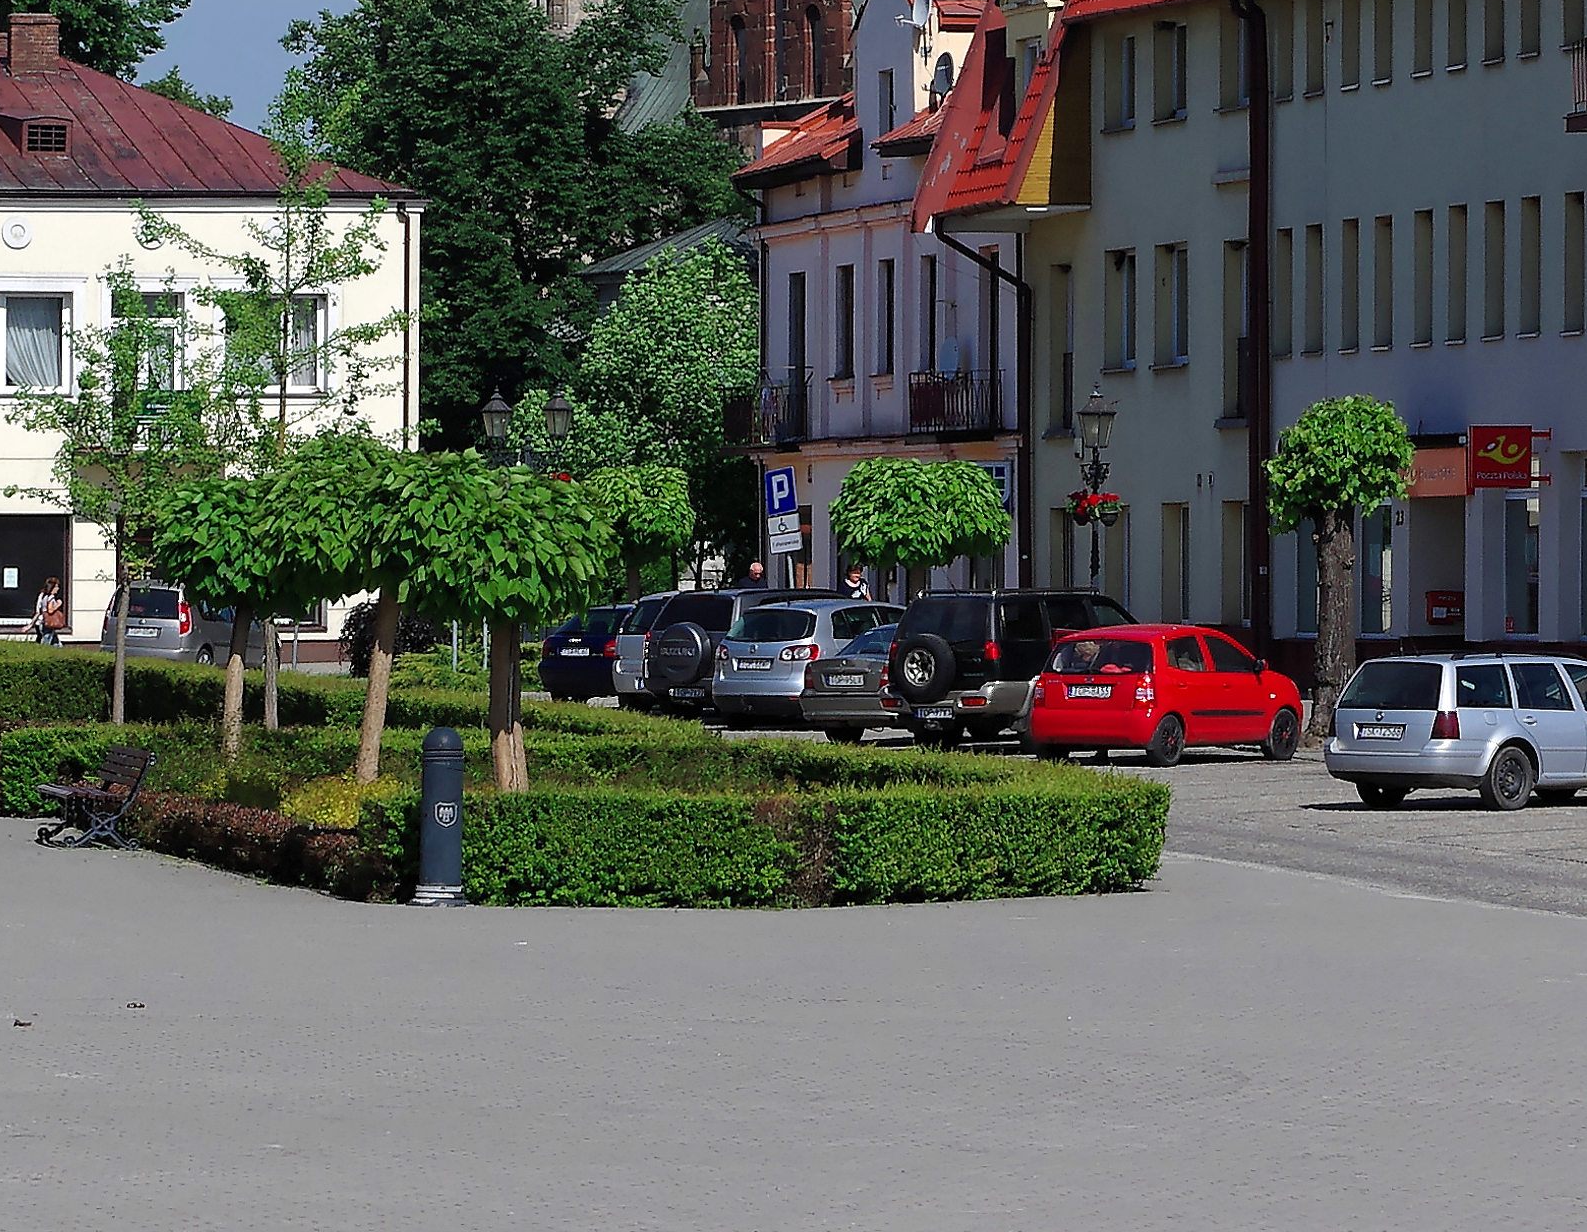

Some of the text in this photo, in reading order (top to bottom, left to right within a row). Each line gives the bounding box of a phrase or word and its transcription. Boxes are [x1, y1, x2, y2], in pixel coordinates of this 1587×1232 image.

[1476, 470, 1528, 479] Poczta Polska
[771, 474, 790, 510] P
